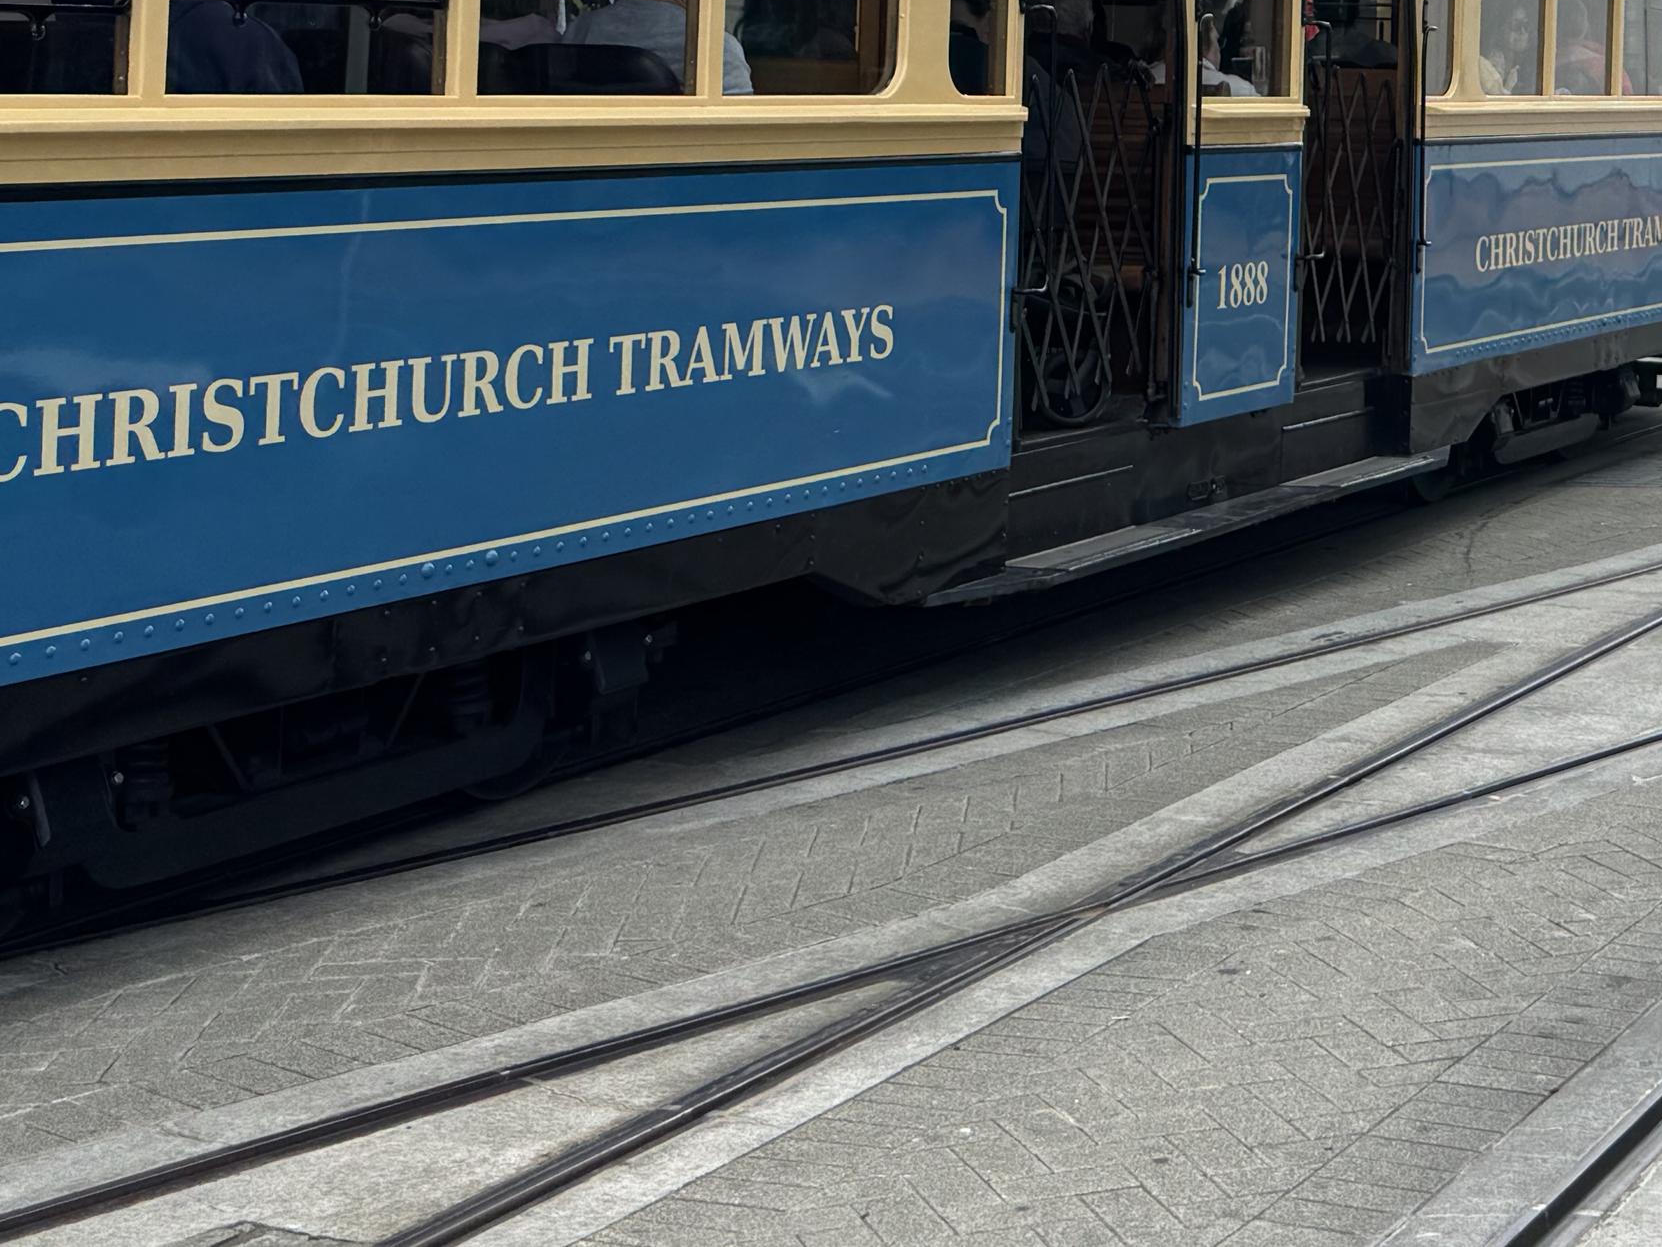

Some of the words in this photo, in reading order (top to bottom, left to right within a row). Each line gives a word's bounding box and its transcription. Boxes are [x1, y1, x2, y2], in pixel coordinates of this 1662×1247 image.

[1475, 219, 1619, 272] CHRISTCHURCH
[1216, 261, 1269, 309] 1888
[0, 338, 593, 483] CHRISTCHURCH
[609, 304, 894, 396] TRAMWAYS
